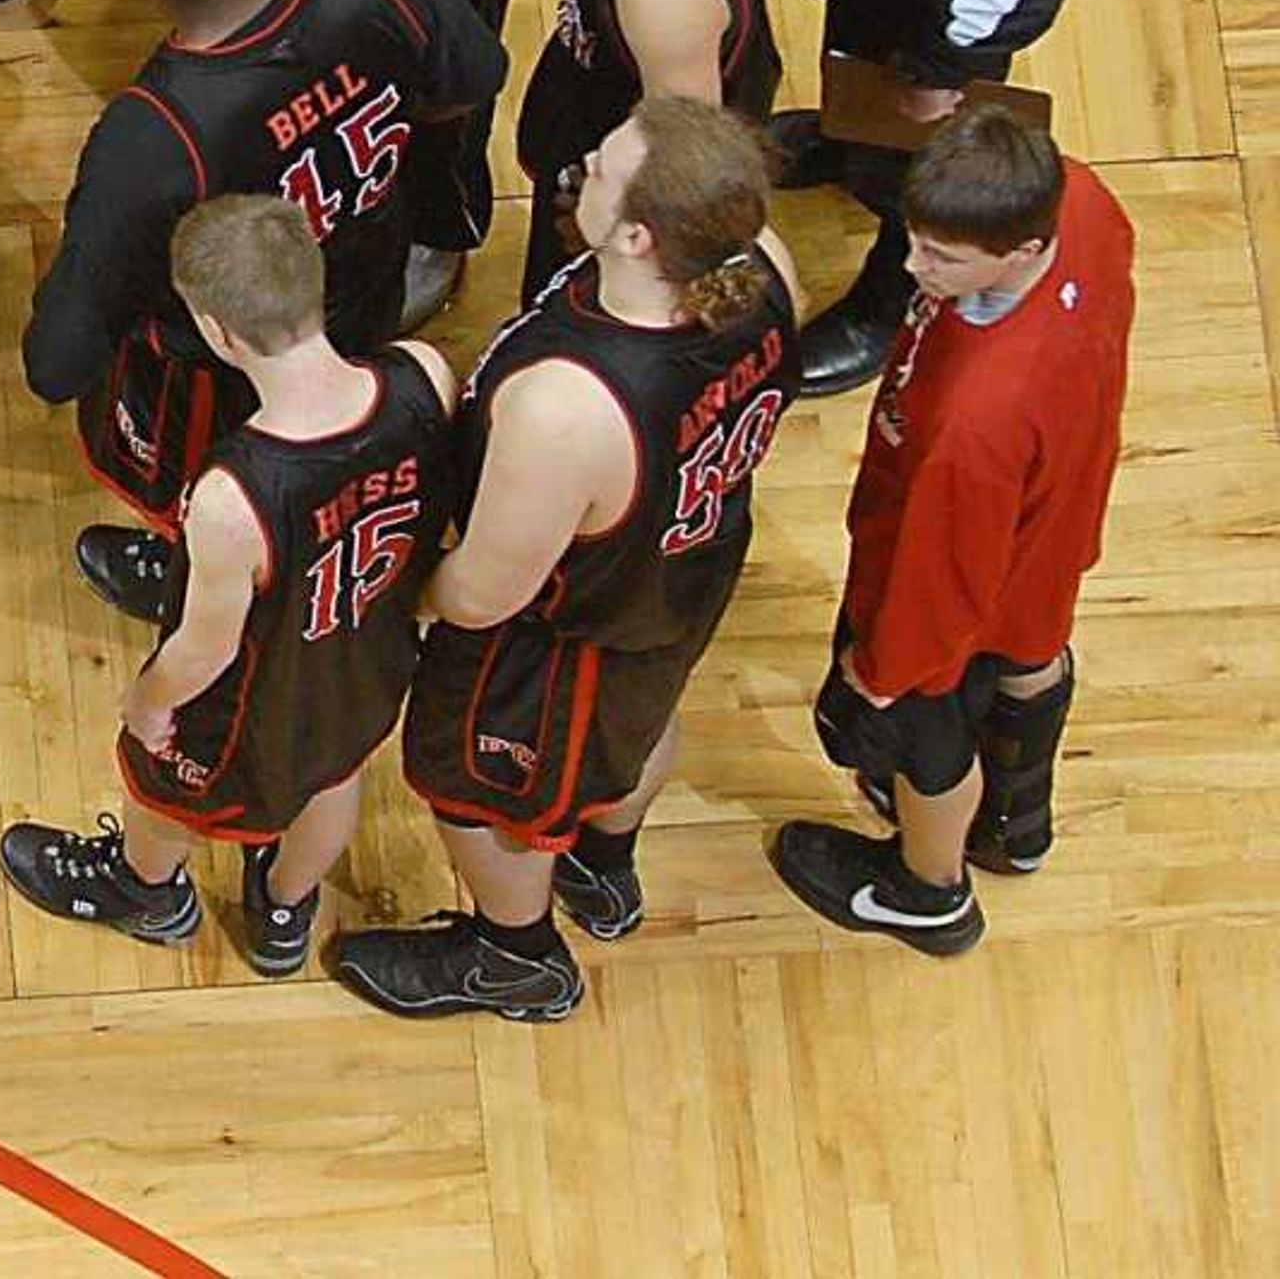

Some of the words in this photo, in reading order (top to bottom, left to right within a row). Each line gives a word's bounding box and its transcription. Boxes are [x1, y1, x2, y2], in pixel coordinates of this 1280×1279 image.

[267, 65, 367, 151] BELL
[660, 389, 783, 557] 50
[302, 498, 421, 642] 15
